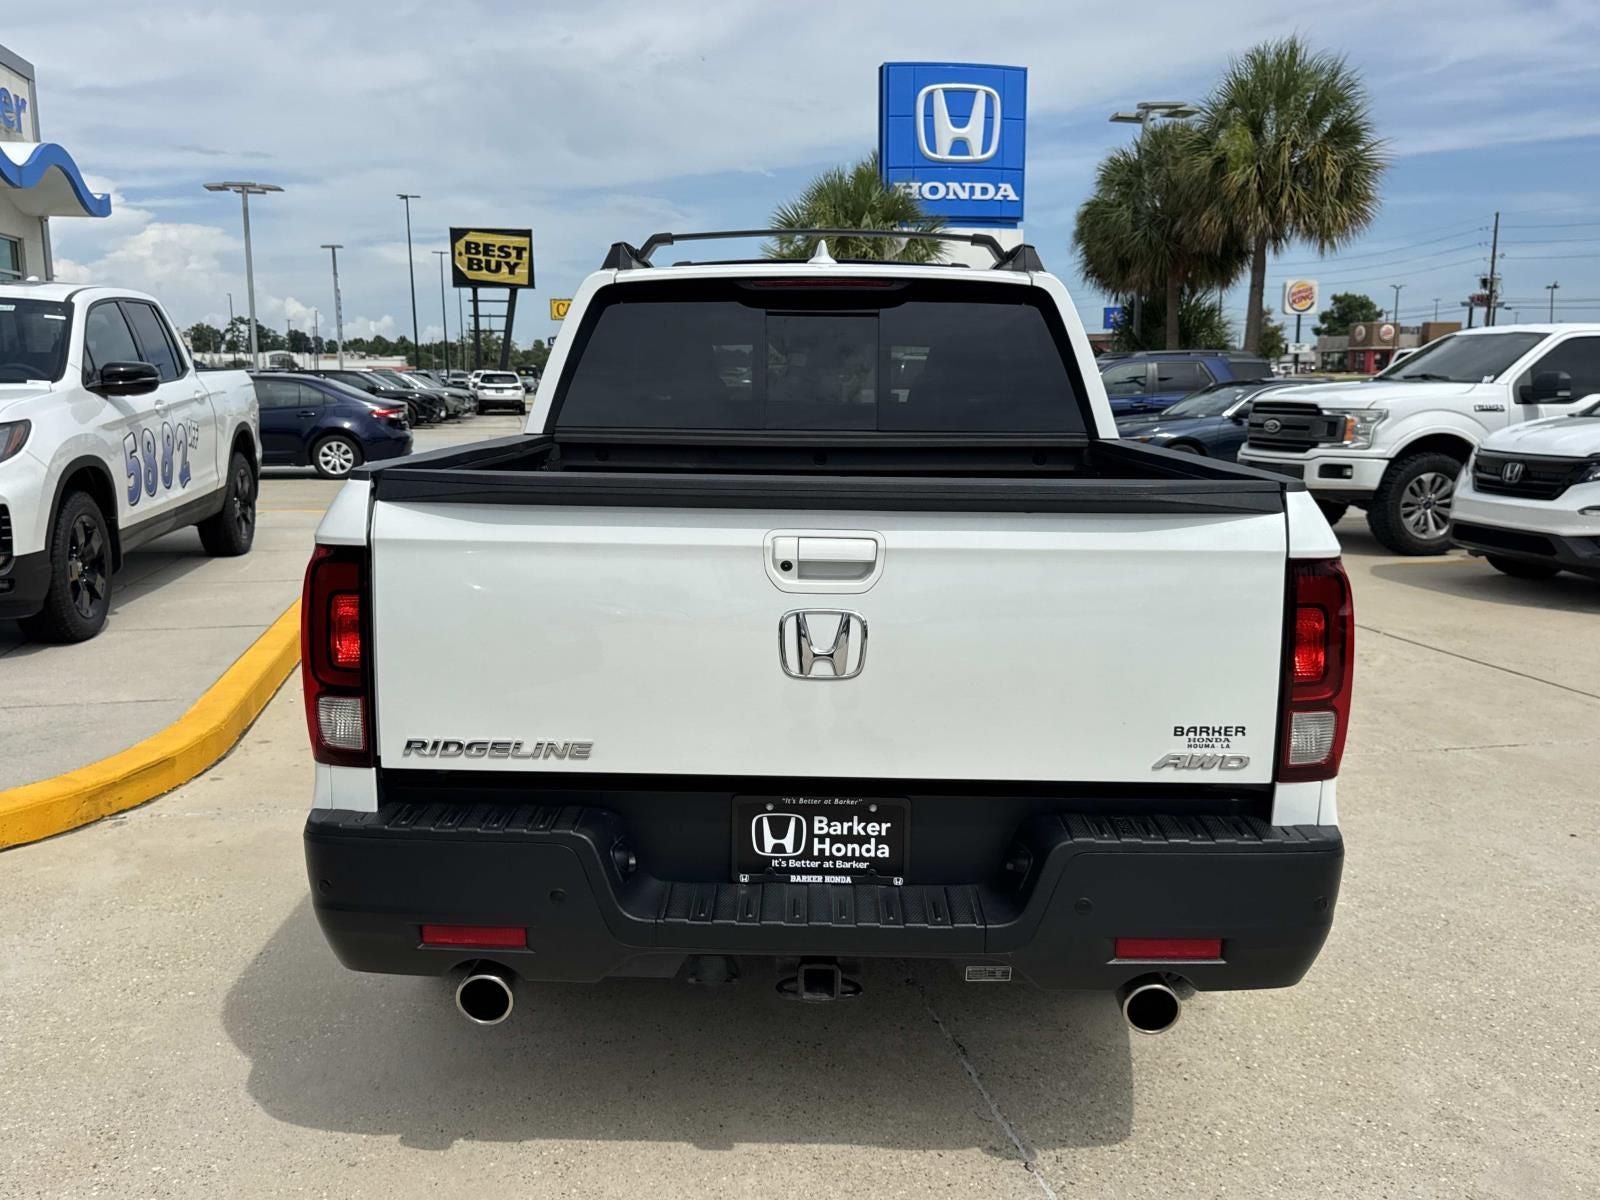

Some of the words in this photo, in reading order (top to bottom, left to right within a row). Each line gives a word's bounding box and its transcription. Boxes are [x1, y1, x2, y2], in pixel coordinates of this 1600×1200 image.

[893, 182, 1019, 200] HONDA
[465, 240, 527, 260] BEST
[467, 257, 521, 275] BUY
[123, 421, 191, 506] 5882
[1173, 726, 1246, 737] BARKER
[402, 739, 594, 760] RIDGELINE
[1152, 753, 1250, 770] AWD
[813, 816, 891, 836] Barker
[813, 837, 890, 858] Honda
[771, 858, 787, 868] It's
[789, 859, 821, 868] Better
[823, 860, 834, 868] at
[836, 860, 869, 869] Barker
[790, 875, 823, 883] BARKER
[824, 875, 852, 884] HONDA
